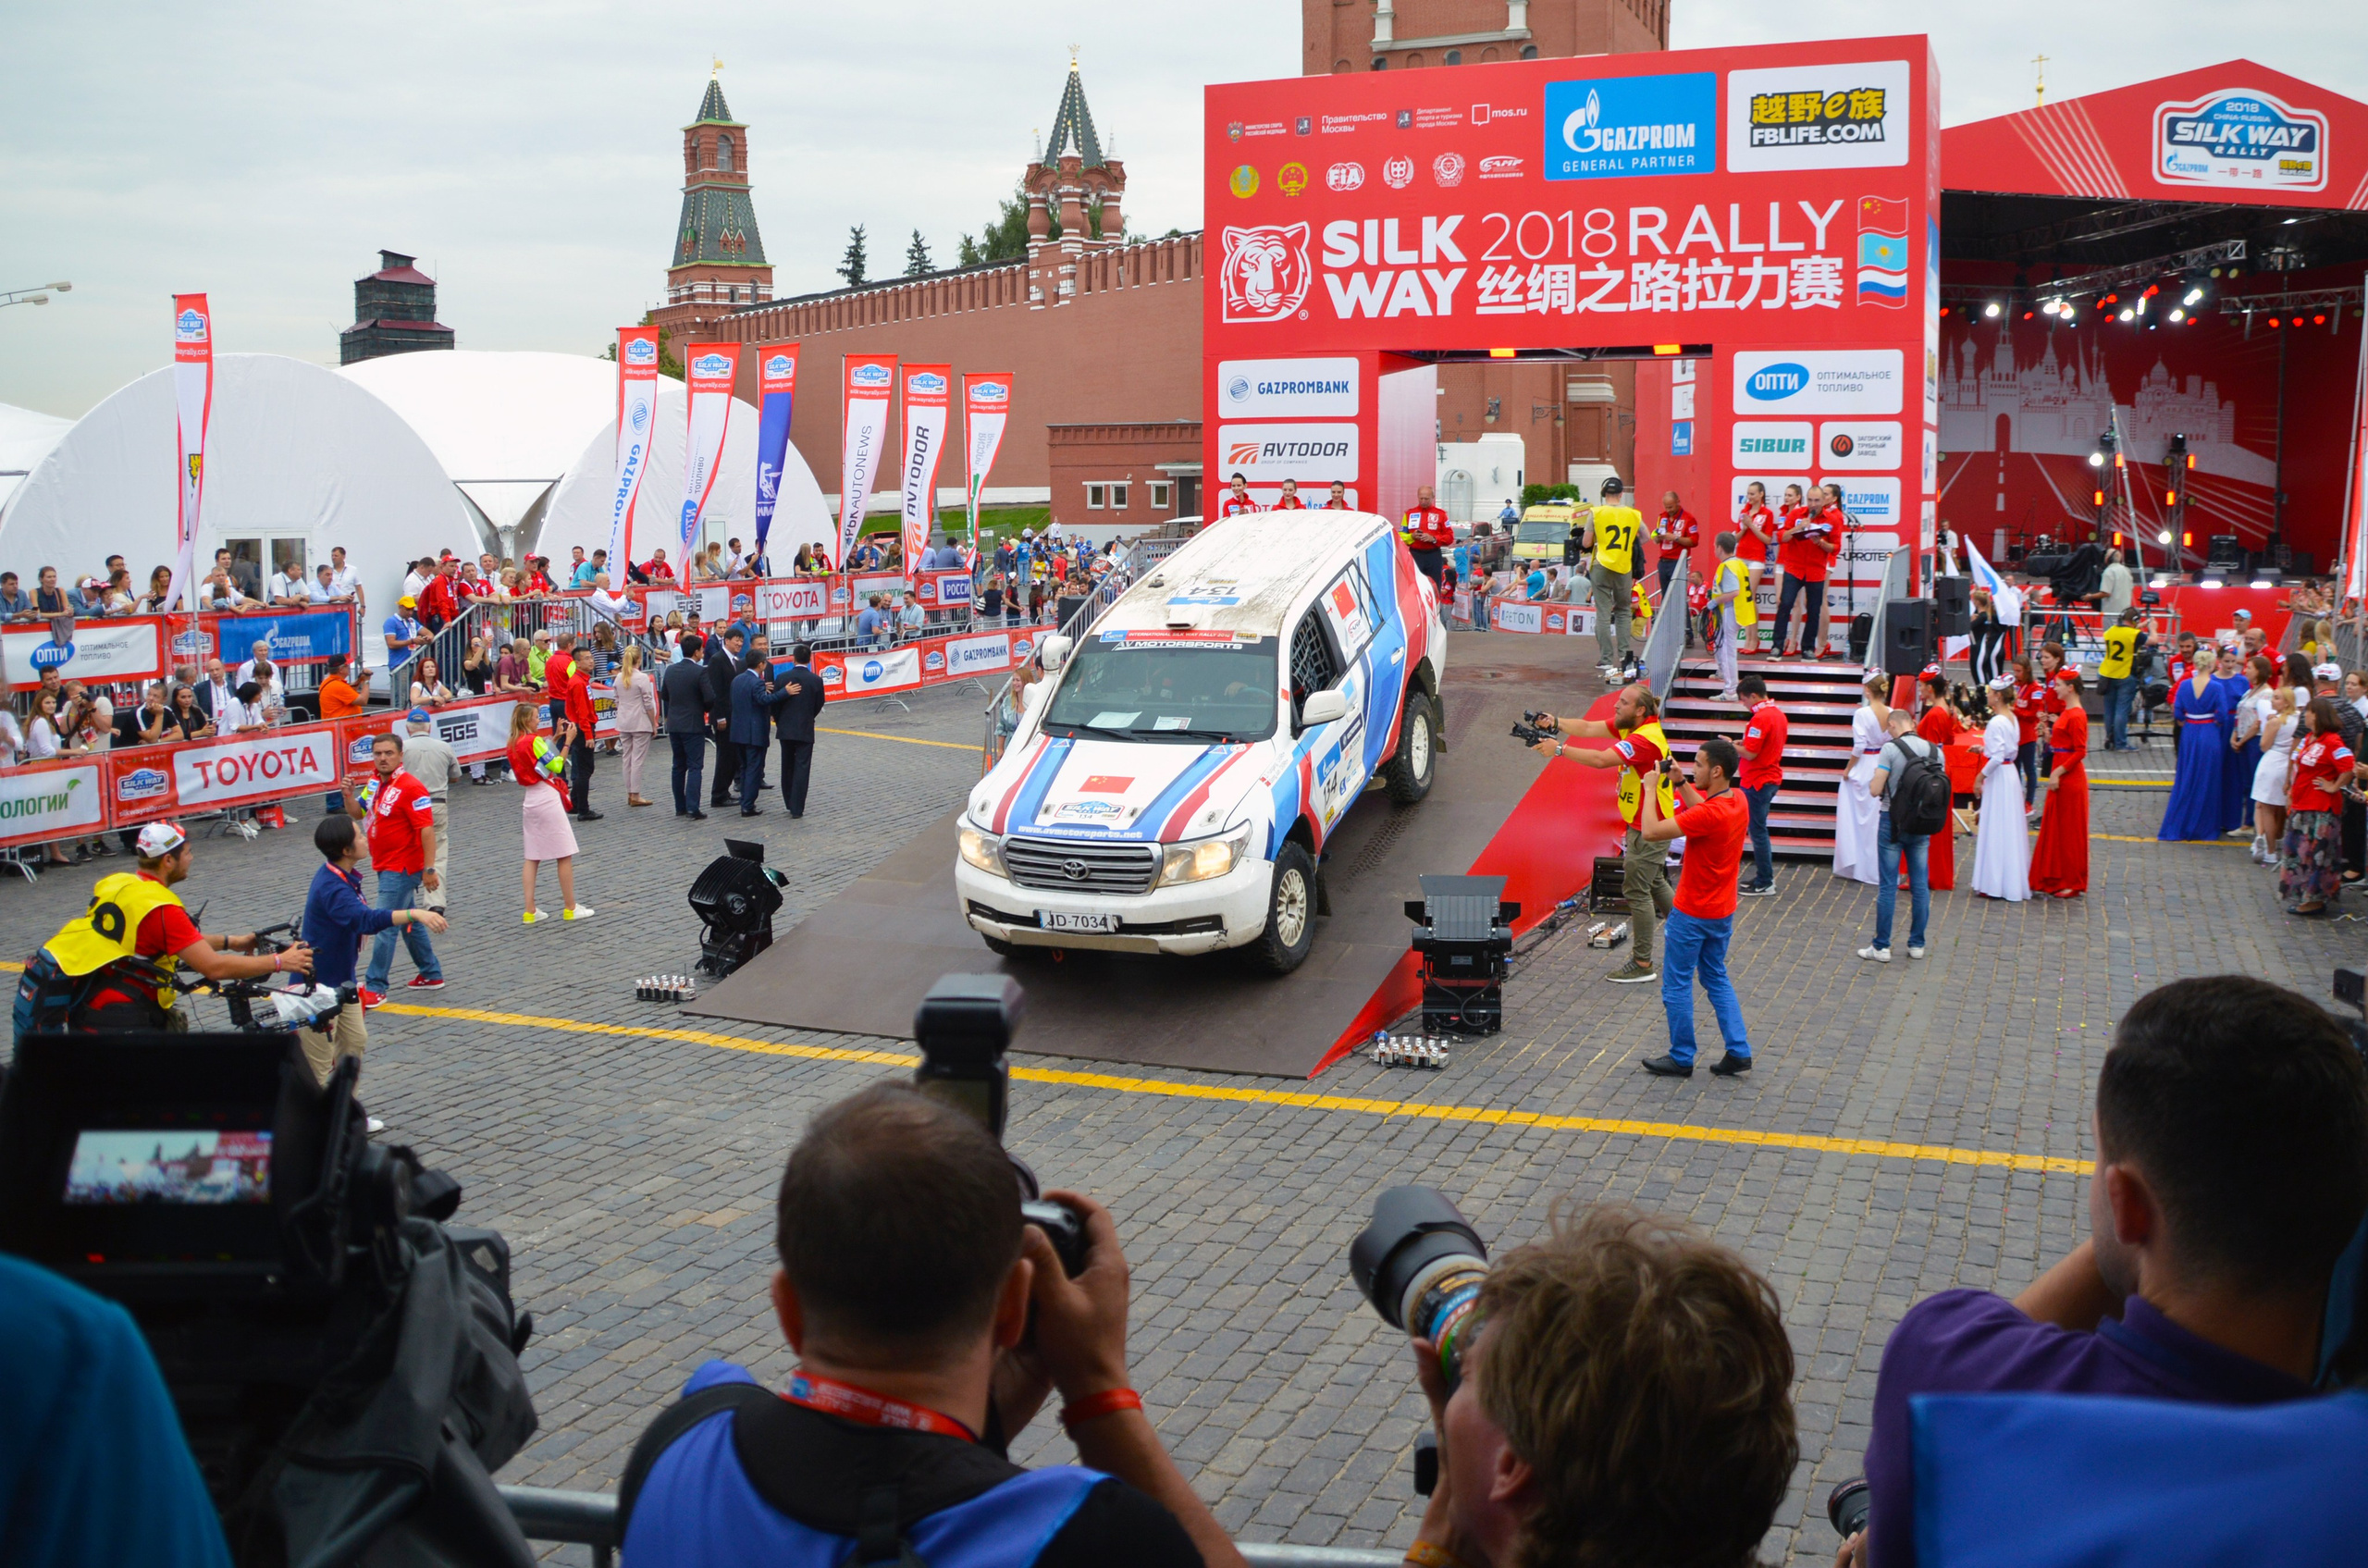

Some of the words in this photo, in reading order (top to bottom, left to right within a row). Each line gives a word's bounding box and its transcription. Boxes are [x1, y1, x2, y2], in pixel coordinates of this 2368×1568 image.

[1416, 107, 1452, 116] Департамент
[1491, 108, 1528, 117] mos.ru
[1750, 87, 1886, 125] 越野e族
[2225, 102, 2260, 113] 2018
[1321, 113, 1388, 125] Правительство
[2213, 113, 2272, 123] CHINA-RUSSIA
[1321, 125, 1355, 133] Москвы
[1751, 122, 1882, 146] FBLIFE.COM
[2173, 121, 2244, 144] SILK
[2248, 124, 2310, 148] WAY
[1601, 123, 1696, 152] GAZPROM
[2214, 146, 2269, 156] RALLY
[1562, 157, 1625, 173] GENERAL
[1631, 154, 1696, 170] PARTNER
[1480, 208, 1618, 262] 2018
[1628, 200, 1845, 256] RALLY
[1323, 215, 1468, 268] SILK
[1476, 254, 1844, 315] 丝绸之路拉力赛
[1323, 267, 1468, 319] WAY
[1755, 373, 1799, 391] ОПТИ
[1817, 370, 1892, 380] ОПТИМАЛЬНОЕ
[1257, 380, 1350, 395] GAZPROMBANK
[1817, 383, 1864, 392] ТОПЛИВО
[1263, 442, 1349, 457] AVTODOR
[1740, 438, 1807, 453] SIBUR
[906, 426, 930, 517] AVTODOR
[1846, 493, 1890, 505] GAZPROM
[1605, 524, 1632, 552] 21
[946, 583, 969, 597] РОССИ
[1188, 586, 1238, 596] 134
[677, 599, 702, 612] SGS
[80, 641, 130, 652] ОПТИМАЛЬНОЕ
[278, 635, 311, 648] GAZPROM
[1134, 640, 1243, 650] MOTORSPORTS
[36, 648, 68, 663] ОПТИ
[80, 652, 112, 661] ТОПЛИВО
[2104, 638, 2126, 662] 12
[439, 722, 478, 744] SGS
[191, 746, 319, 789] TOYOTA
[123, 779, 143, 789] SILK
[144, 776, 163, 785] WAY
[118, 803, 171, 818] silkwayrally.com
[1018, 825, 1143, 840] www.avmotorsports.net
